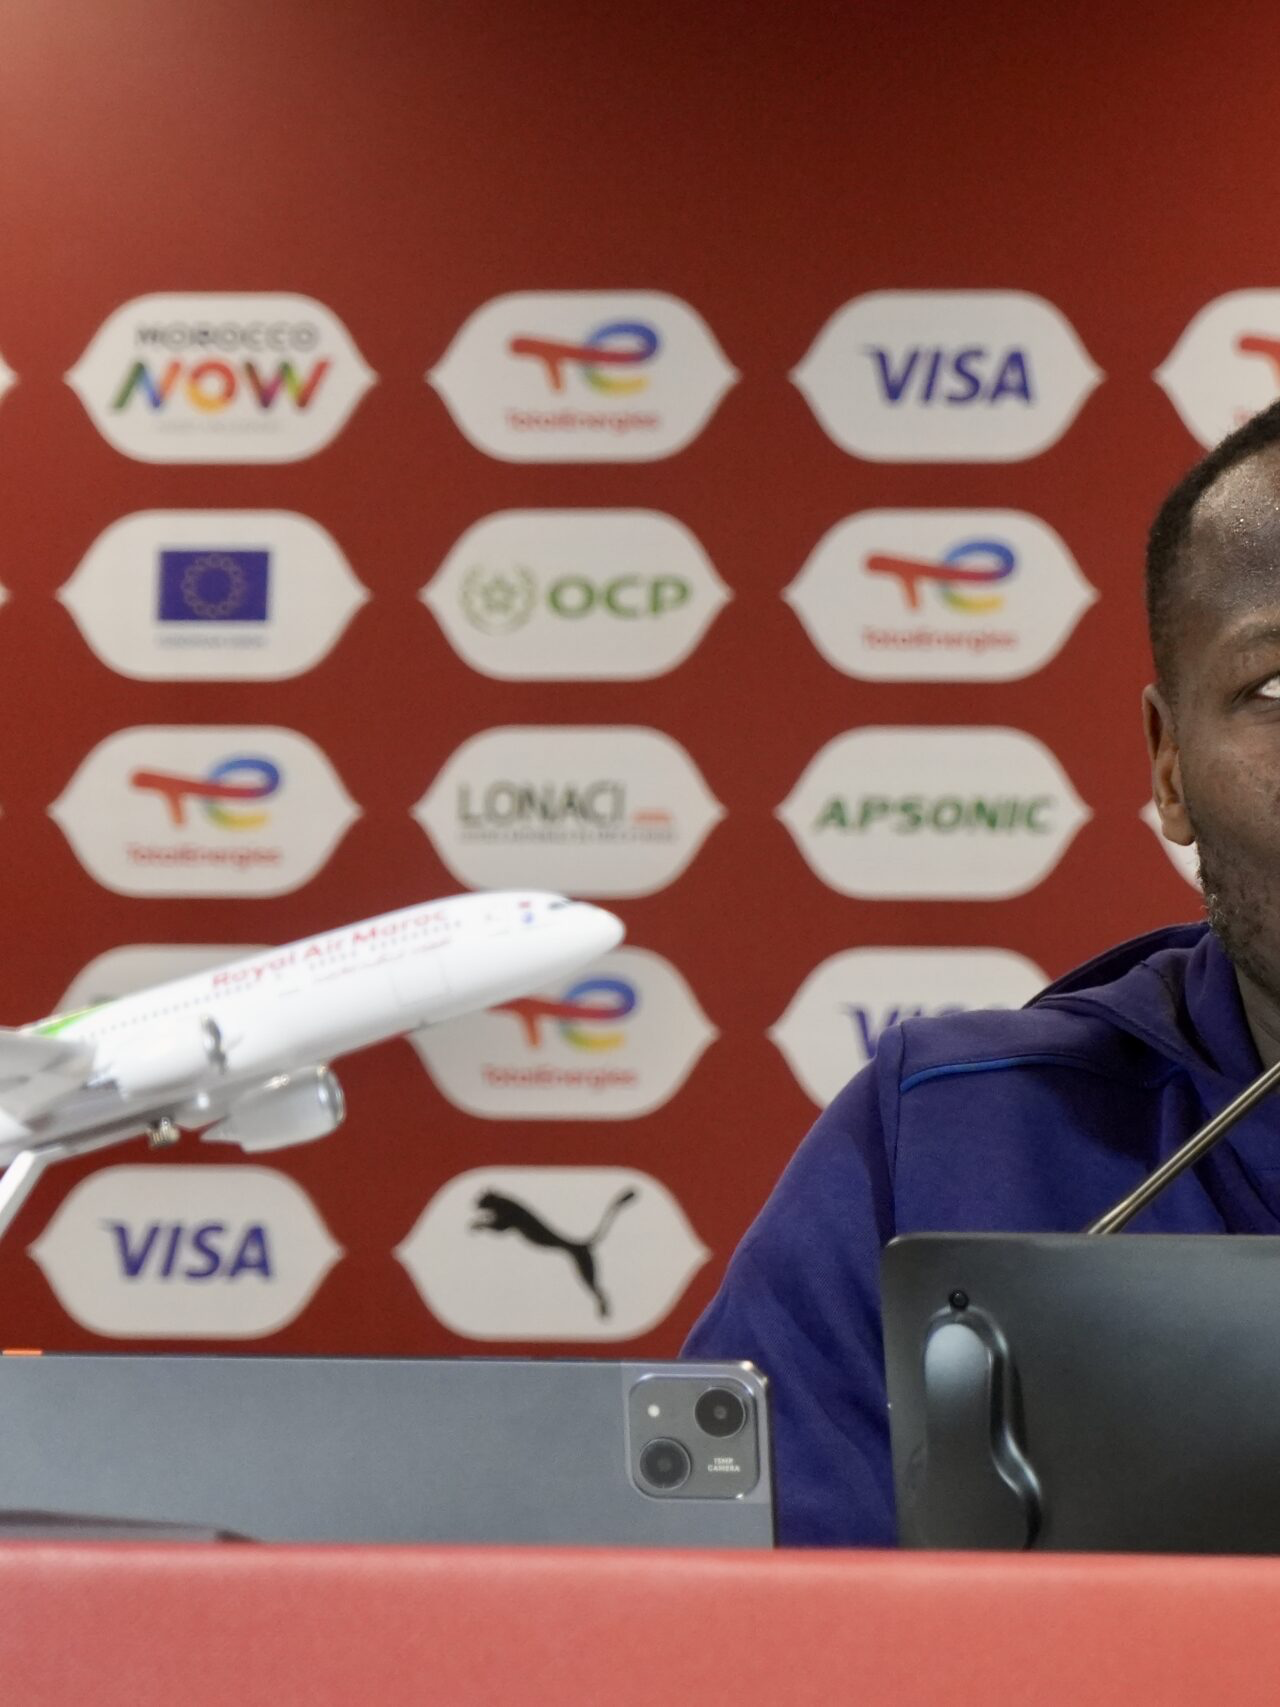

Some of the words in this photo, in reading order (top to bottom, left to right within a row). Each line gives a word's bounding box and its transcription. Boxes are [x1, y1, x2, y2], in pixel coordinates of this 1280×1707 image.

[134, 321, 320, 351] MOROCCO
[111, 358, 333, 412] NOW
[865, 344, 1035, 407] VISA
[546, 575, 694, 622] OCP
[457, 780, 627, 829] LONACI
[813, 794, 1058, 834] APSONIC
[212, 951, 296, 987] Royal
[303, 939, 342, 961] Air
[352, 910, 448, 945] Maroc
[102, 1216, 275, 1281] VISA
